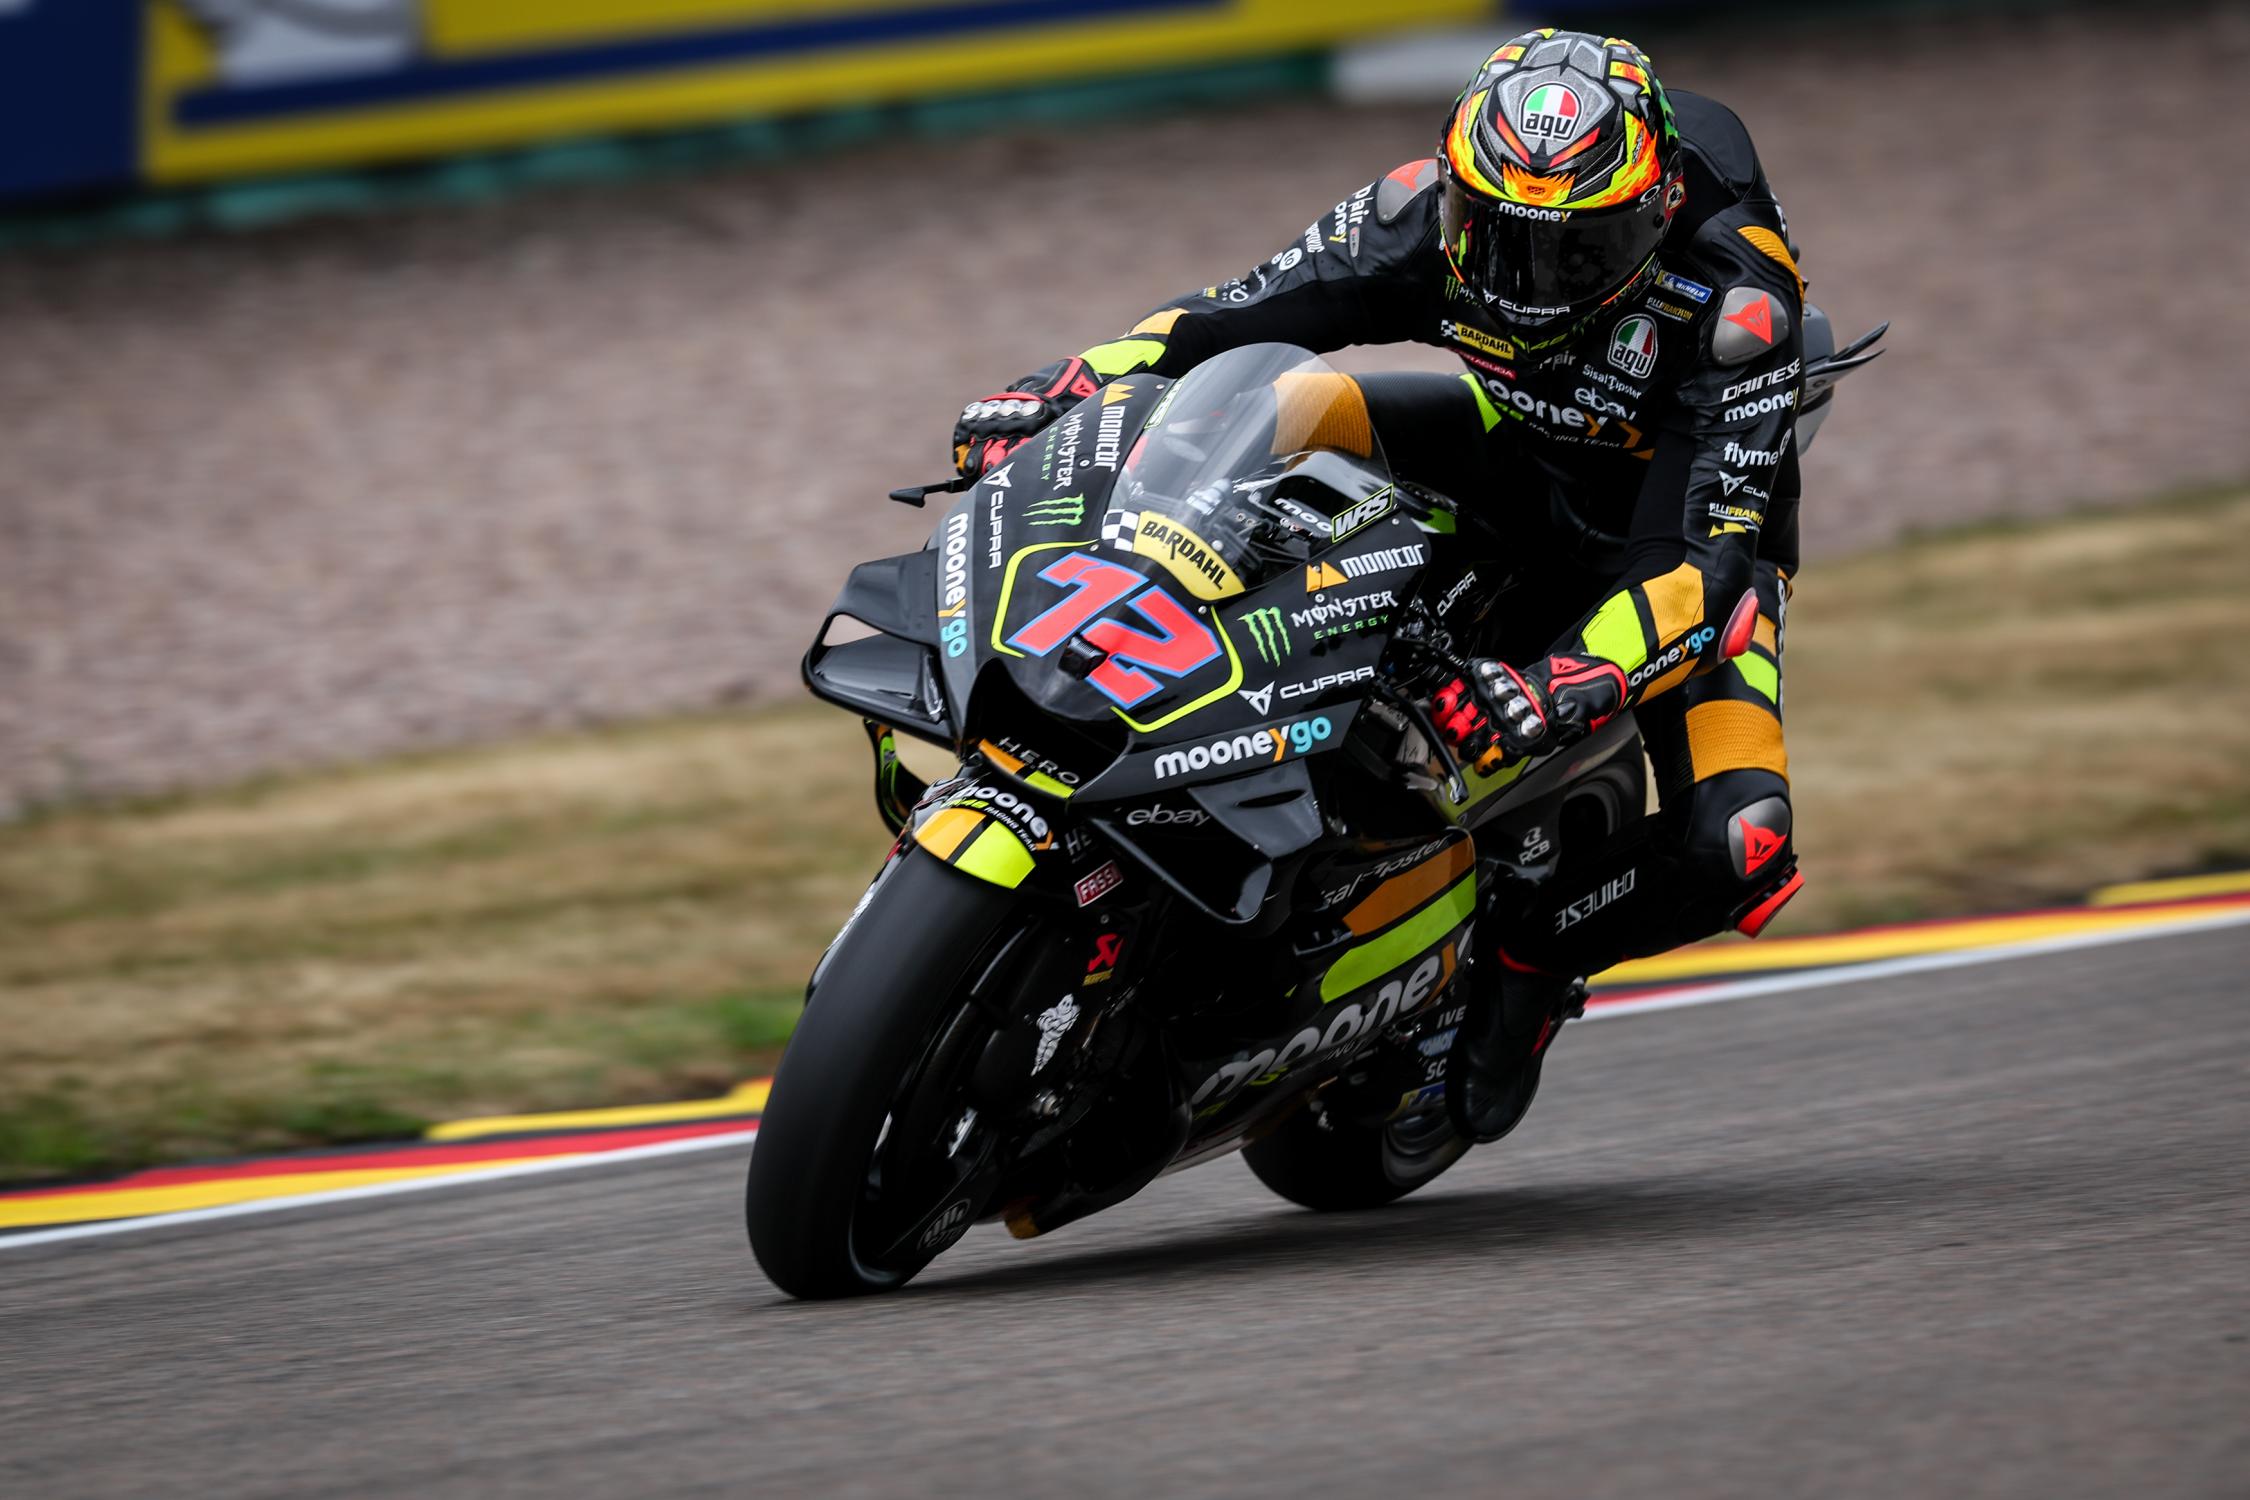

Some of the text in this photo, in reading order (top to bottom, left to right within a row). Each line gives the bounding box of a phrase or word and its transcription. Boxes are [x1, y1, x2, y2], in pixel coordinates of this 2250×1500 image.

[1524, 111, 1573, 138] agv
[1499, 200, 1572, 223] mooney
[1499, 300, 1571, 315] CUPRA
[1459, 326, 1512, 355] BARDAHL
[1613, 343, 1649, 376] agv
[1721, 357, 1801, 403] DAINESE
[1724, 387, 1800, 423] mooney
[1040, 426, 1059, 482] ENERGY
[1052, 412, 1085, 492] MONSTER
[1723, 441, 1780, 469] flyme
[988, 490, 1005, 569] CUPRA
[1139, 519, 1226, 591] BARDAHL
[937, 512, 970, 658] mooneygo
[1436, 570, 1478, 617] CUPRA
[1289, 589, 1399, 629] MONSTER
[1313, 614, 1390, 641] ENERGY
[1626, 625, 1716, 688] ooneygo
[1279, 665, 1375, 700] CUPRA
[997, 735, 1081, 786] HERO
[1153, 715, 1333, 780] mooneygo
[1125, 803, 1210, 828] ebay
[1518, 840, 1551, 866] RCB
[1080, 863, 1120, 902] FASSI
[1554, 867, 1637, 936] DAINESE
